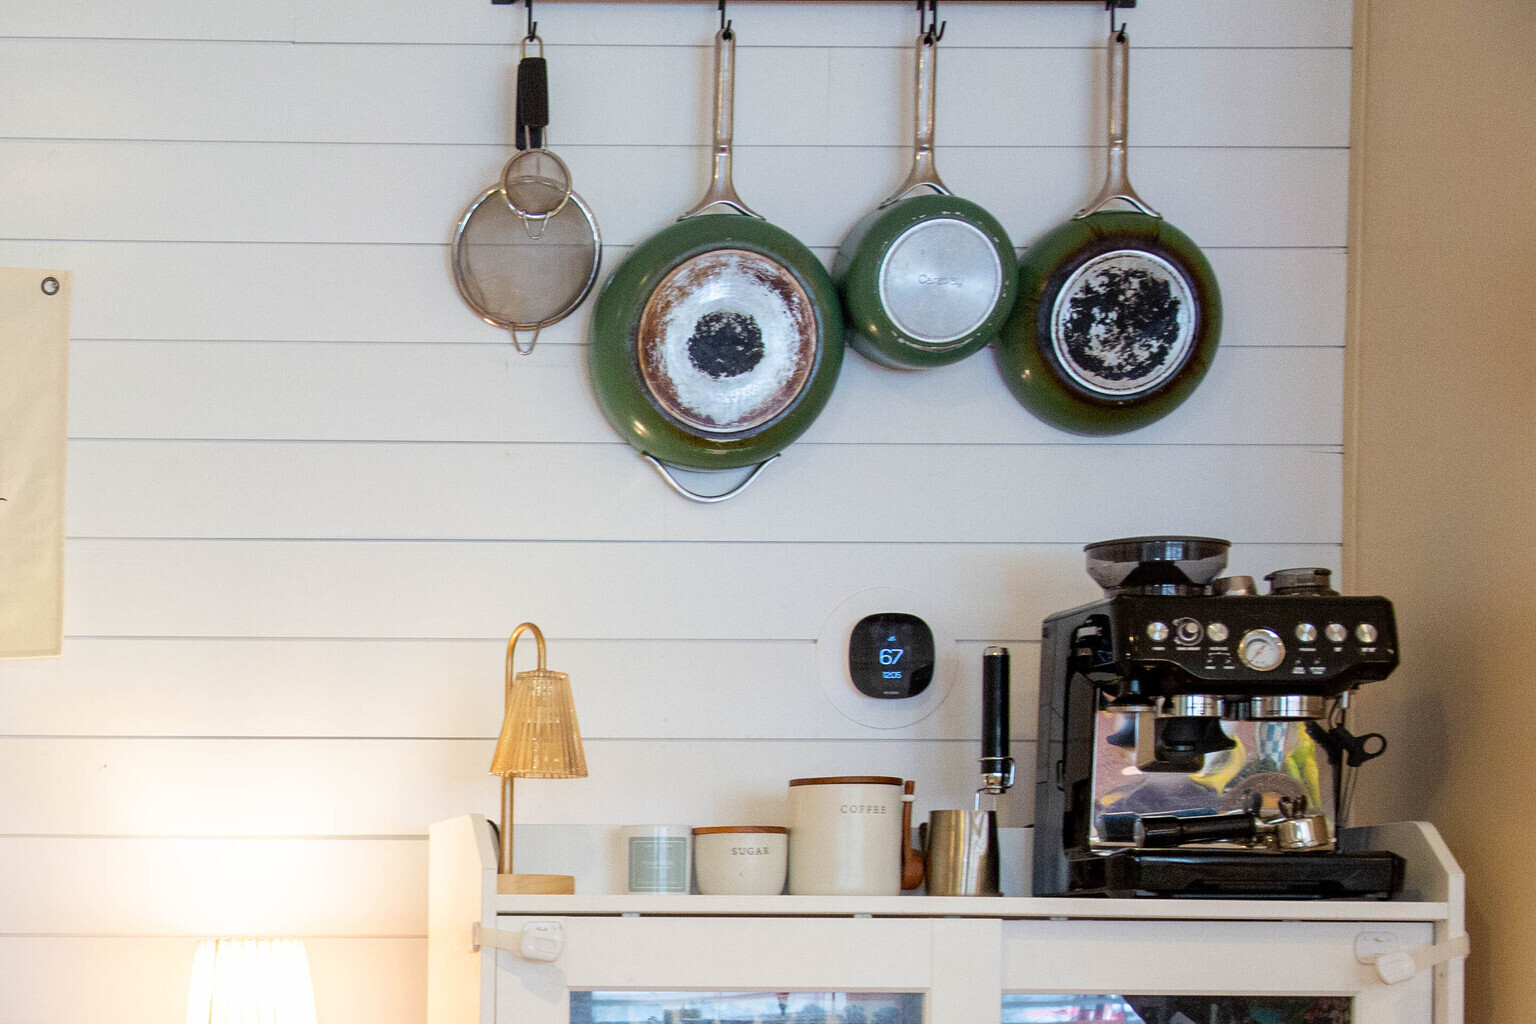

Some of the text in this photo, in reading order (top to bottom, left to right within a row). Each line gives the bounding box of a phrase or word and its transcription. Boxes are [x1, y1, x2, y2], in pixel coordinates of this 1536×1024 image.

[879, 648, 904, 665] 67
[840, 804, 887, 815] COFFEE
[731, 847, 770, 856] SUGAR
